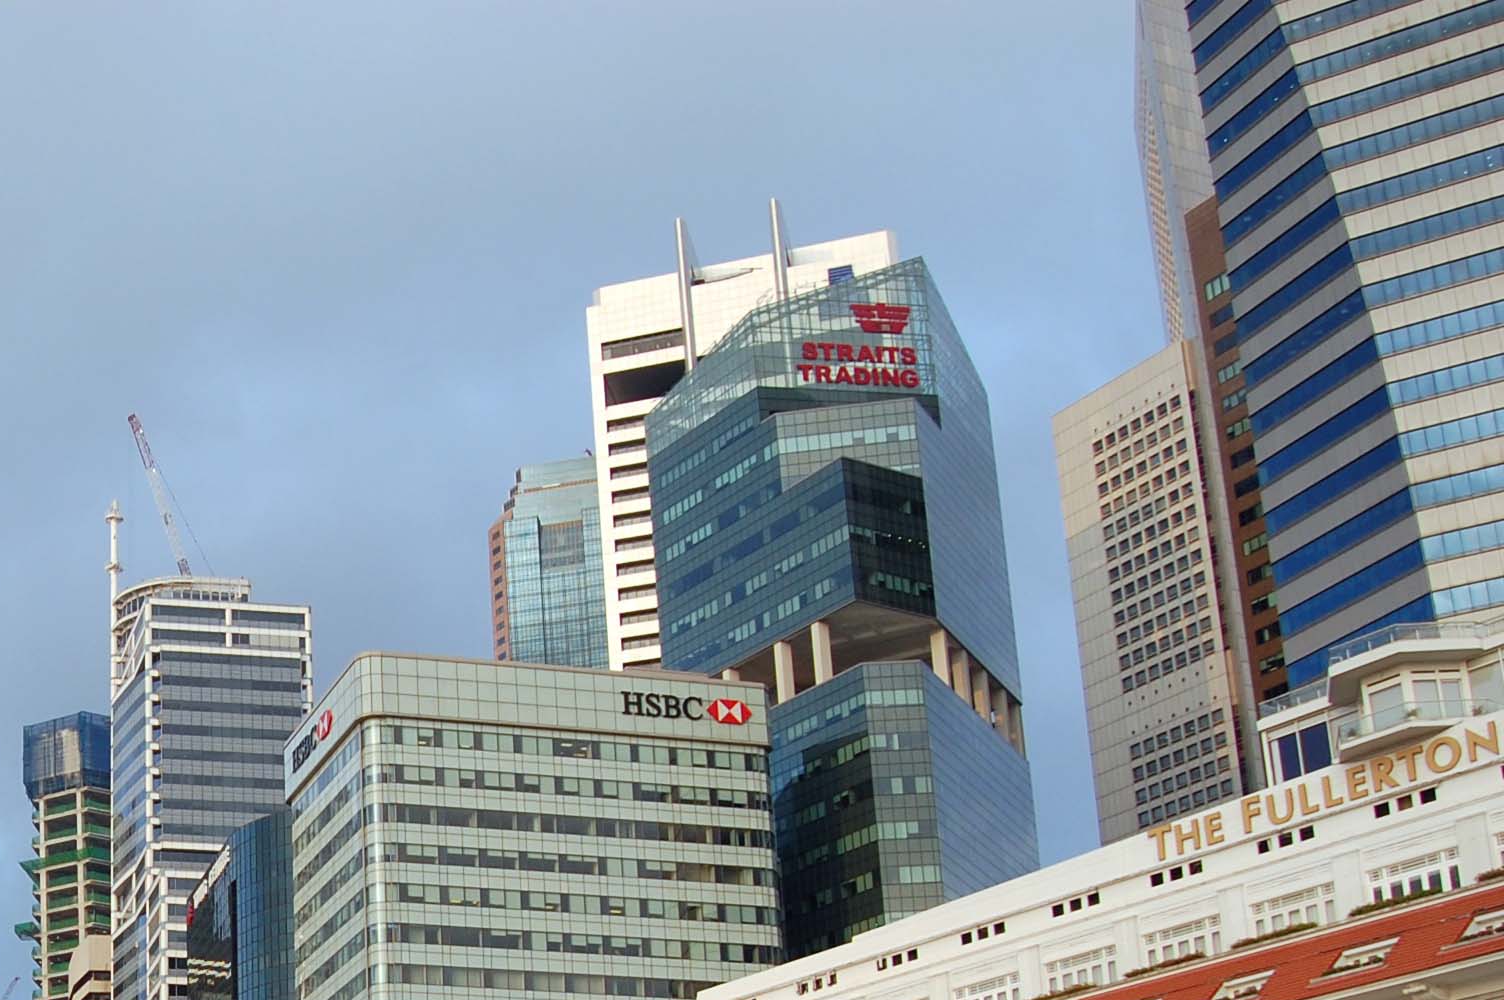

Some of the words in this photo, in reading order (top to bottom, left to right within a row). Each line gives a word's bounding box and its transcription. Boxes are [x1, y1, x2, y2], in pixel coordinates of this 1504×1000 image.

[802, 342, 917, 365] STRAITS
[797, 364, 920, 388] TRADING
[621, 690, 703, 721] HSBC
[292, 724, 317, 774] HSBC
[1148, 811, 1224, 861] THE
[1241, 720, 1499, 833] FULLERTON
